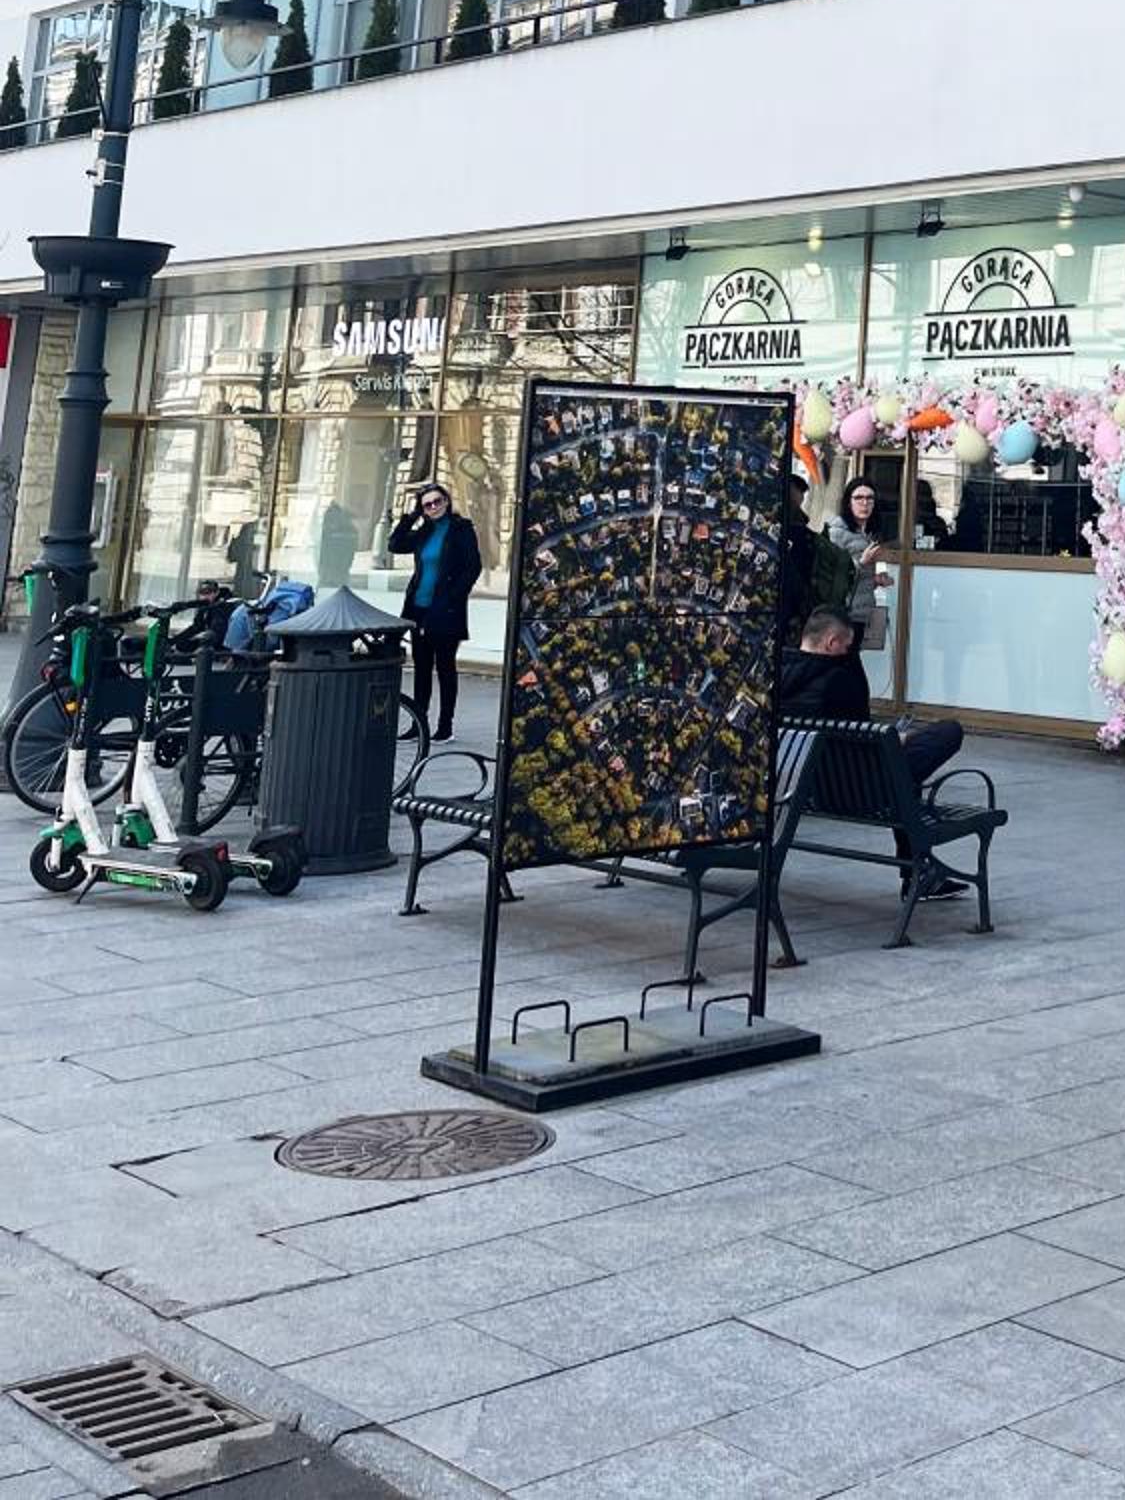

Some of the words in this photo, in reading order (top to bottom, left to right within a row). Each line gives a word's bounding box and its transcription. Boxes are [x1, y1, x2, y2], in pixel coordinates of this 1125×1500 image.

[715, 275, 775, 309] GORĄCA
[961, 257, 1034, 293] GORĄCA
[332, 318, 447, 356] SAMSUN
[685, 329, 801, 368] PĄCZKARNIA
[926, 314, 1071, 359] PĄCZKARNIA
